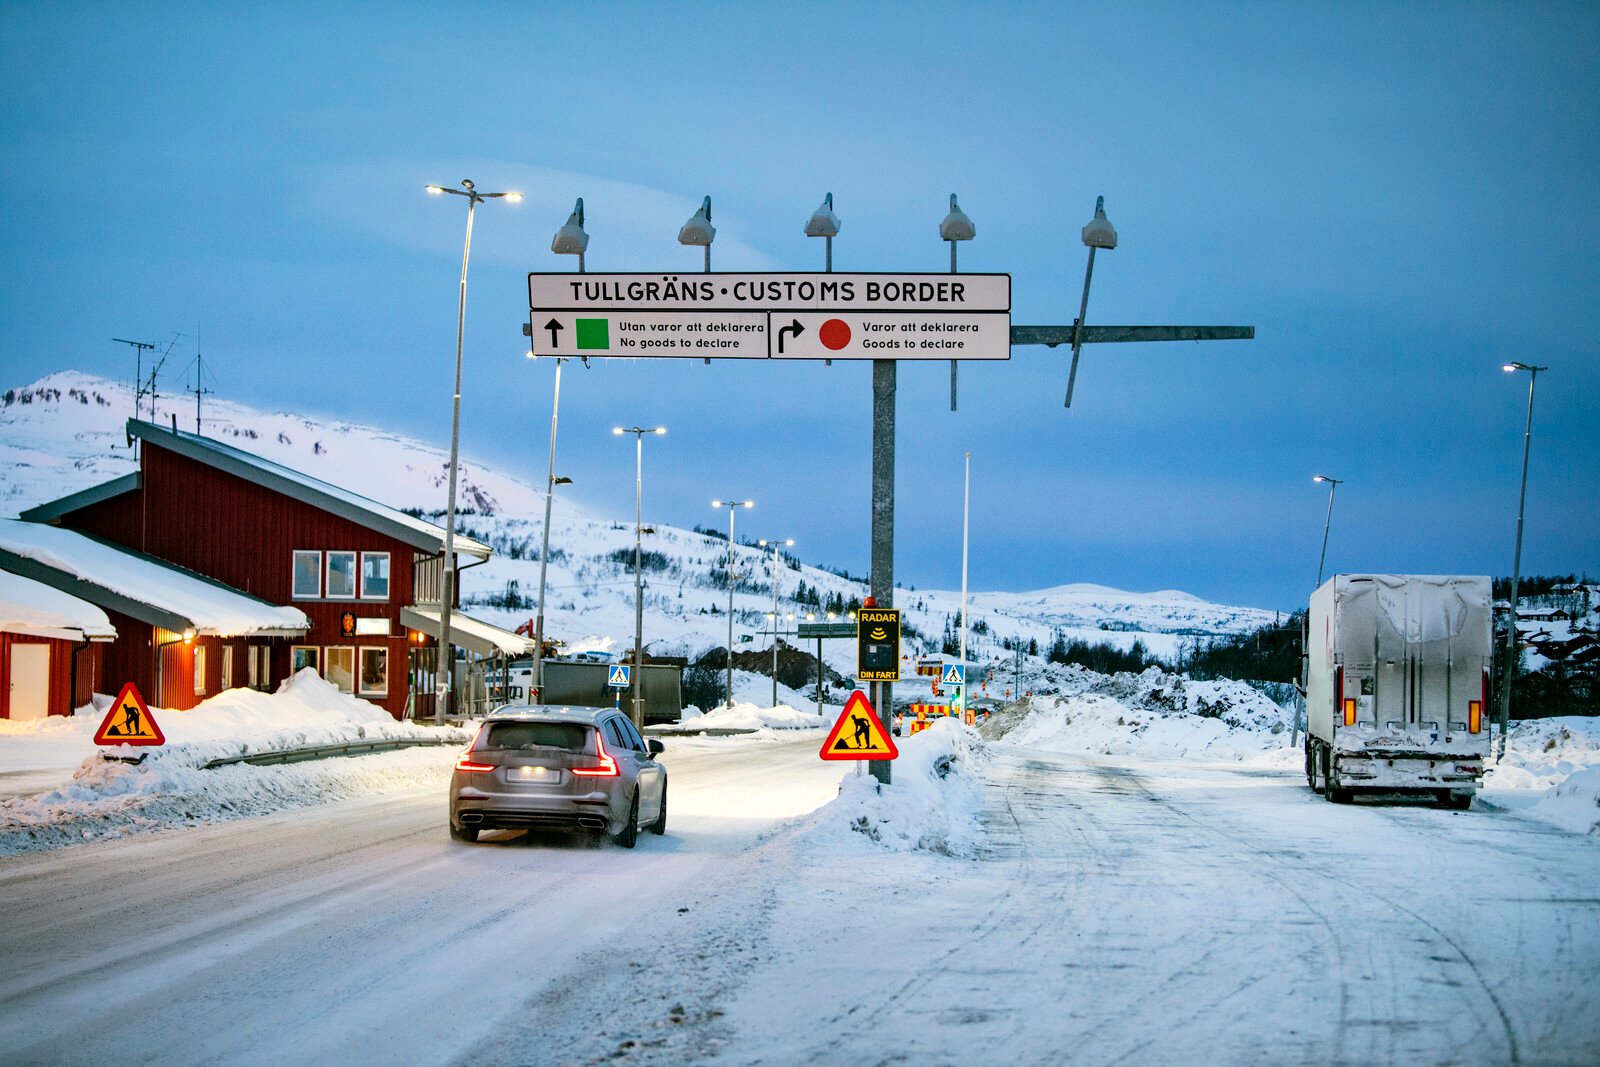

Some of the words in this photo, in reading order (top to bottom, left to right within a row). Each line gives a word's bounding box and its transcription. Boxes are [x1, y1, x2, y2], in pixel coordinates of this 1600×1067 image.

[570, 276, 714, 301] TULLGRÄNS
[733, 281, 855, 301] CUSTOMS
[866, 282, 965, 302] BORDER
[620, 322, 646, 332] Utan
[650, 324, 682, 332] varor
[686, 323, 702, 332] att
[706, 323, 764, 332] deklarera
[862, 322, 896, 332] Varor
[900, 322, 916, 332] att
[920, 322, 979, 332] deklarera
[620, 338, 636, 347] No
[640, 338, 676, 350] goods
[680, 338, 692, 348] to
[696, 338, 740, 348] declare
[862, 339, 900, 349] Goods
[904, 340, 916, 349] to
[920, 340, 964, 349] declare
[861, 613, 897, 622] RADAR
